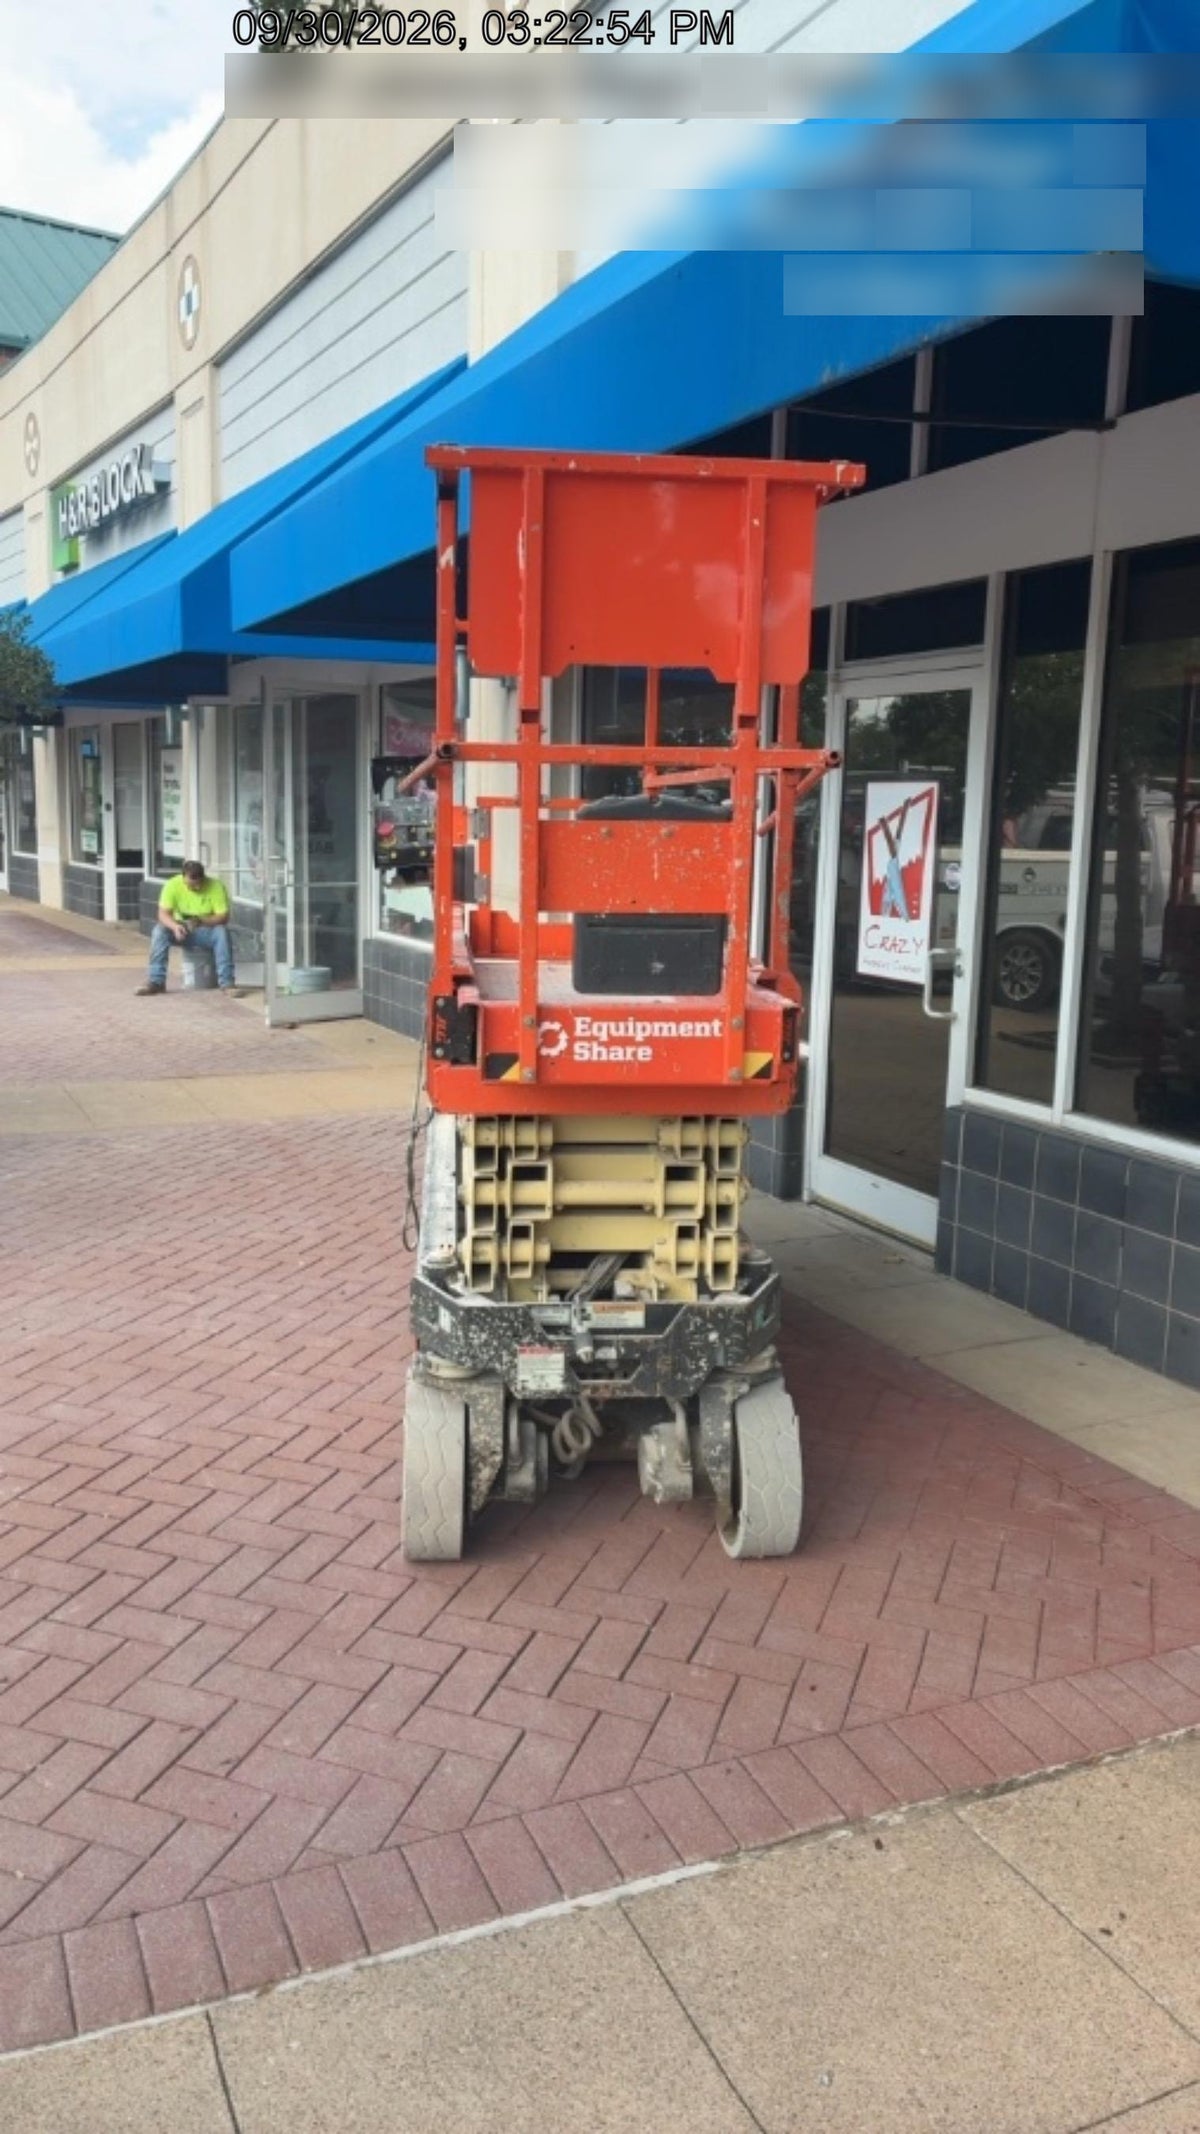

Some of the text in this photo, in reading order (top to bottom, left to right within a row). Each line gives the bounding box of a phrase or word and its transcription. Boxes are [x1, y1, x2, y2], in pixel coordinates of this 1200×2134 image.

[58, 443, 156, 539] H&R BLOCK
[573, 1016, 723, 1041] Equipment
[573, 1041, 653, 1061] Share
